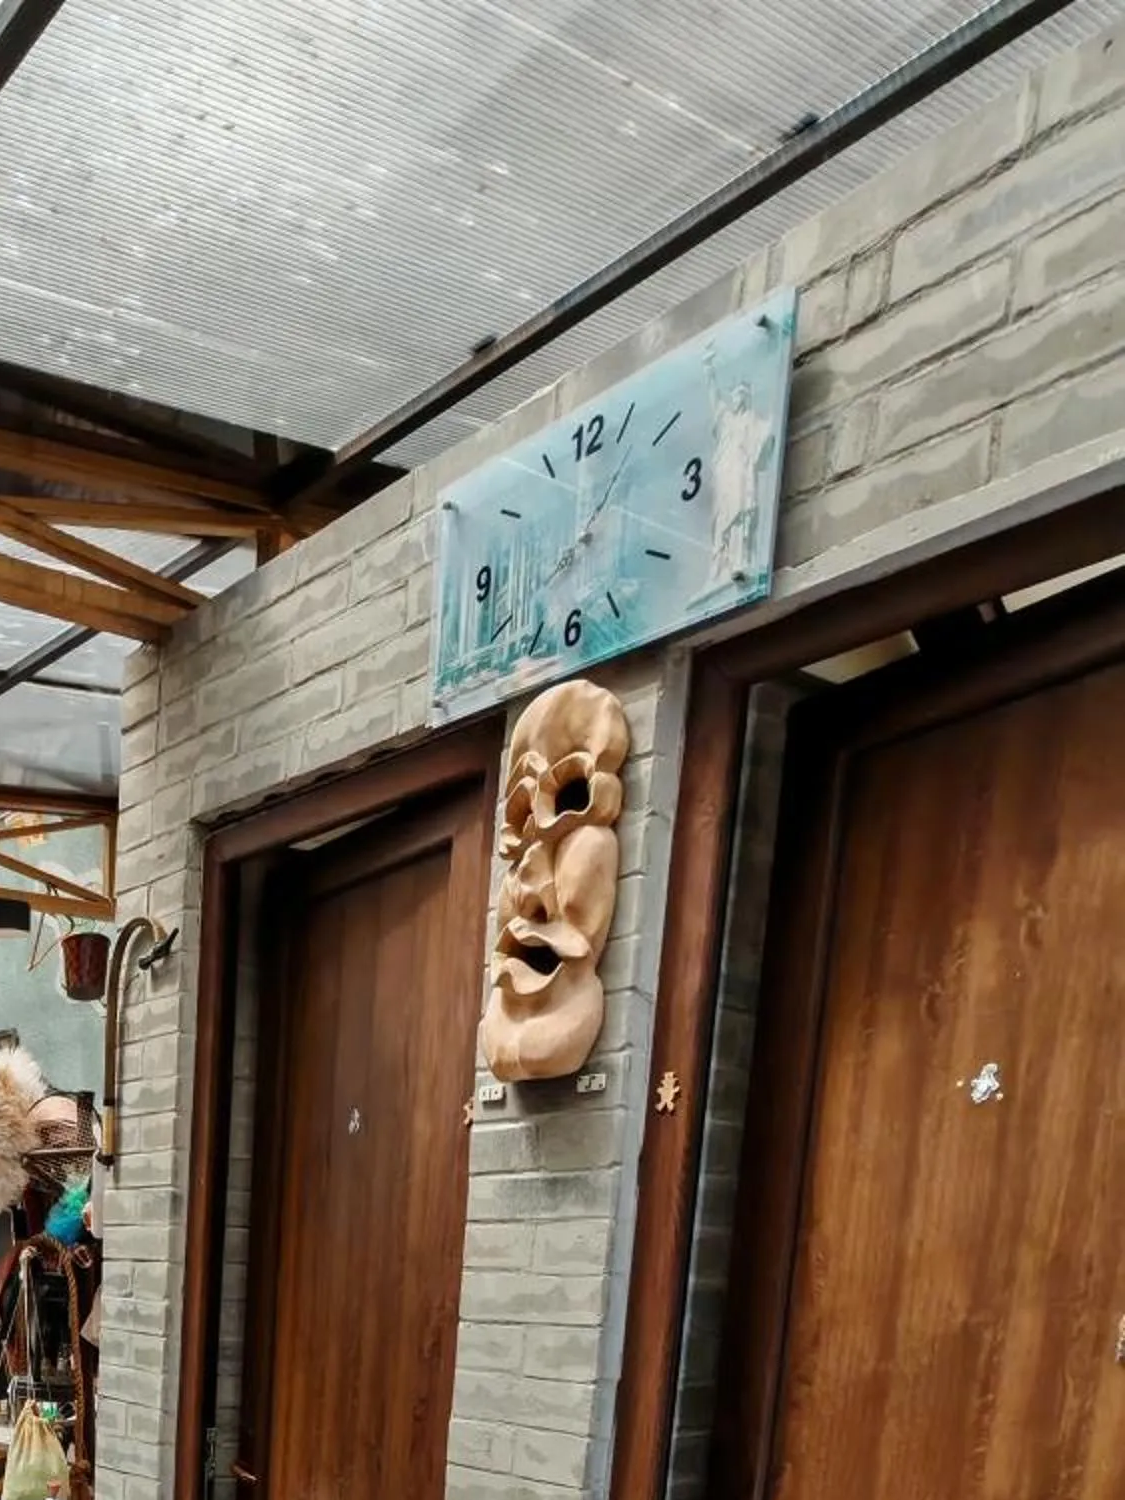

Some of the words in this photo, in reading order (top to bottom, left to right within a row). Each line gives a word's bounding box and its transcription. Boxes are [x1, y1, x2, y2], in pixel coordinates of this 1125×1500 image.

[571, 414, 604, 462] 12
[681, 456, 702, 501] 3
[476, 565, 492, 603] 9
[564, 608, 582, 647] 6
